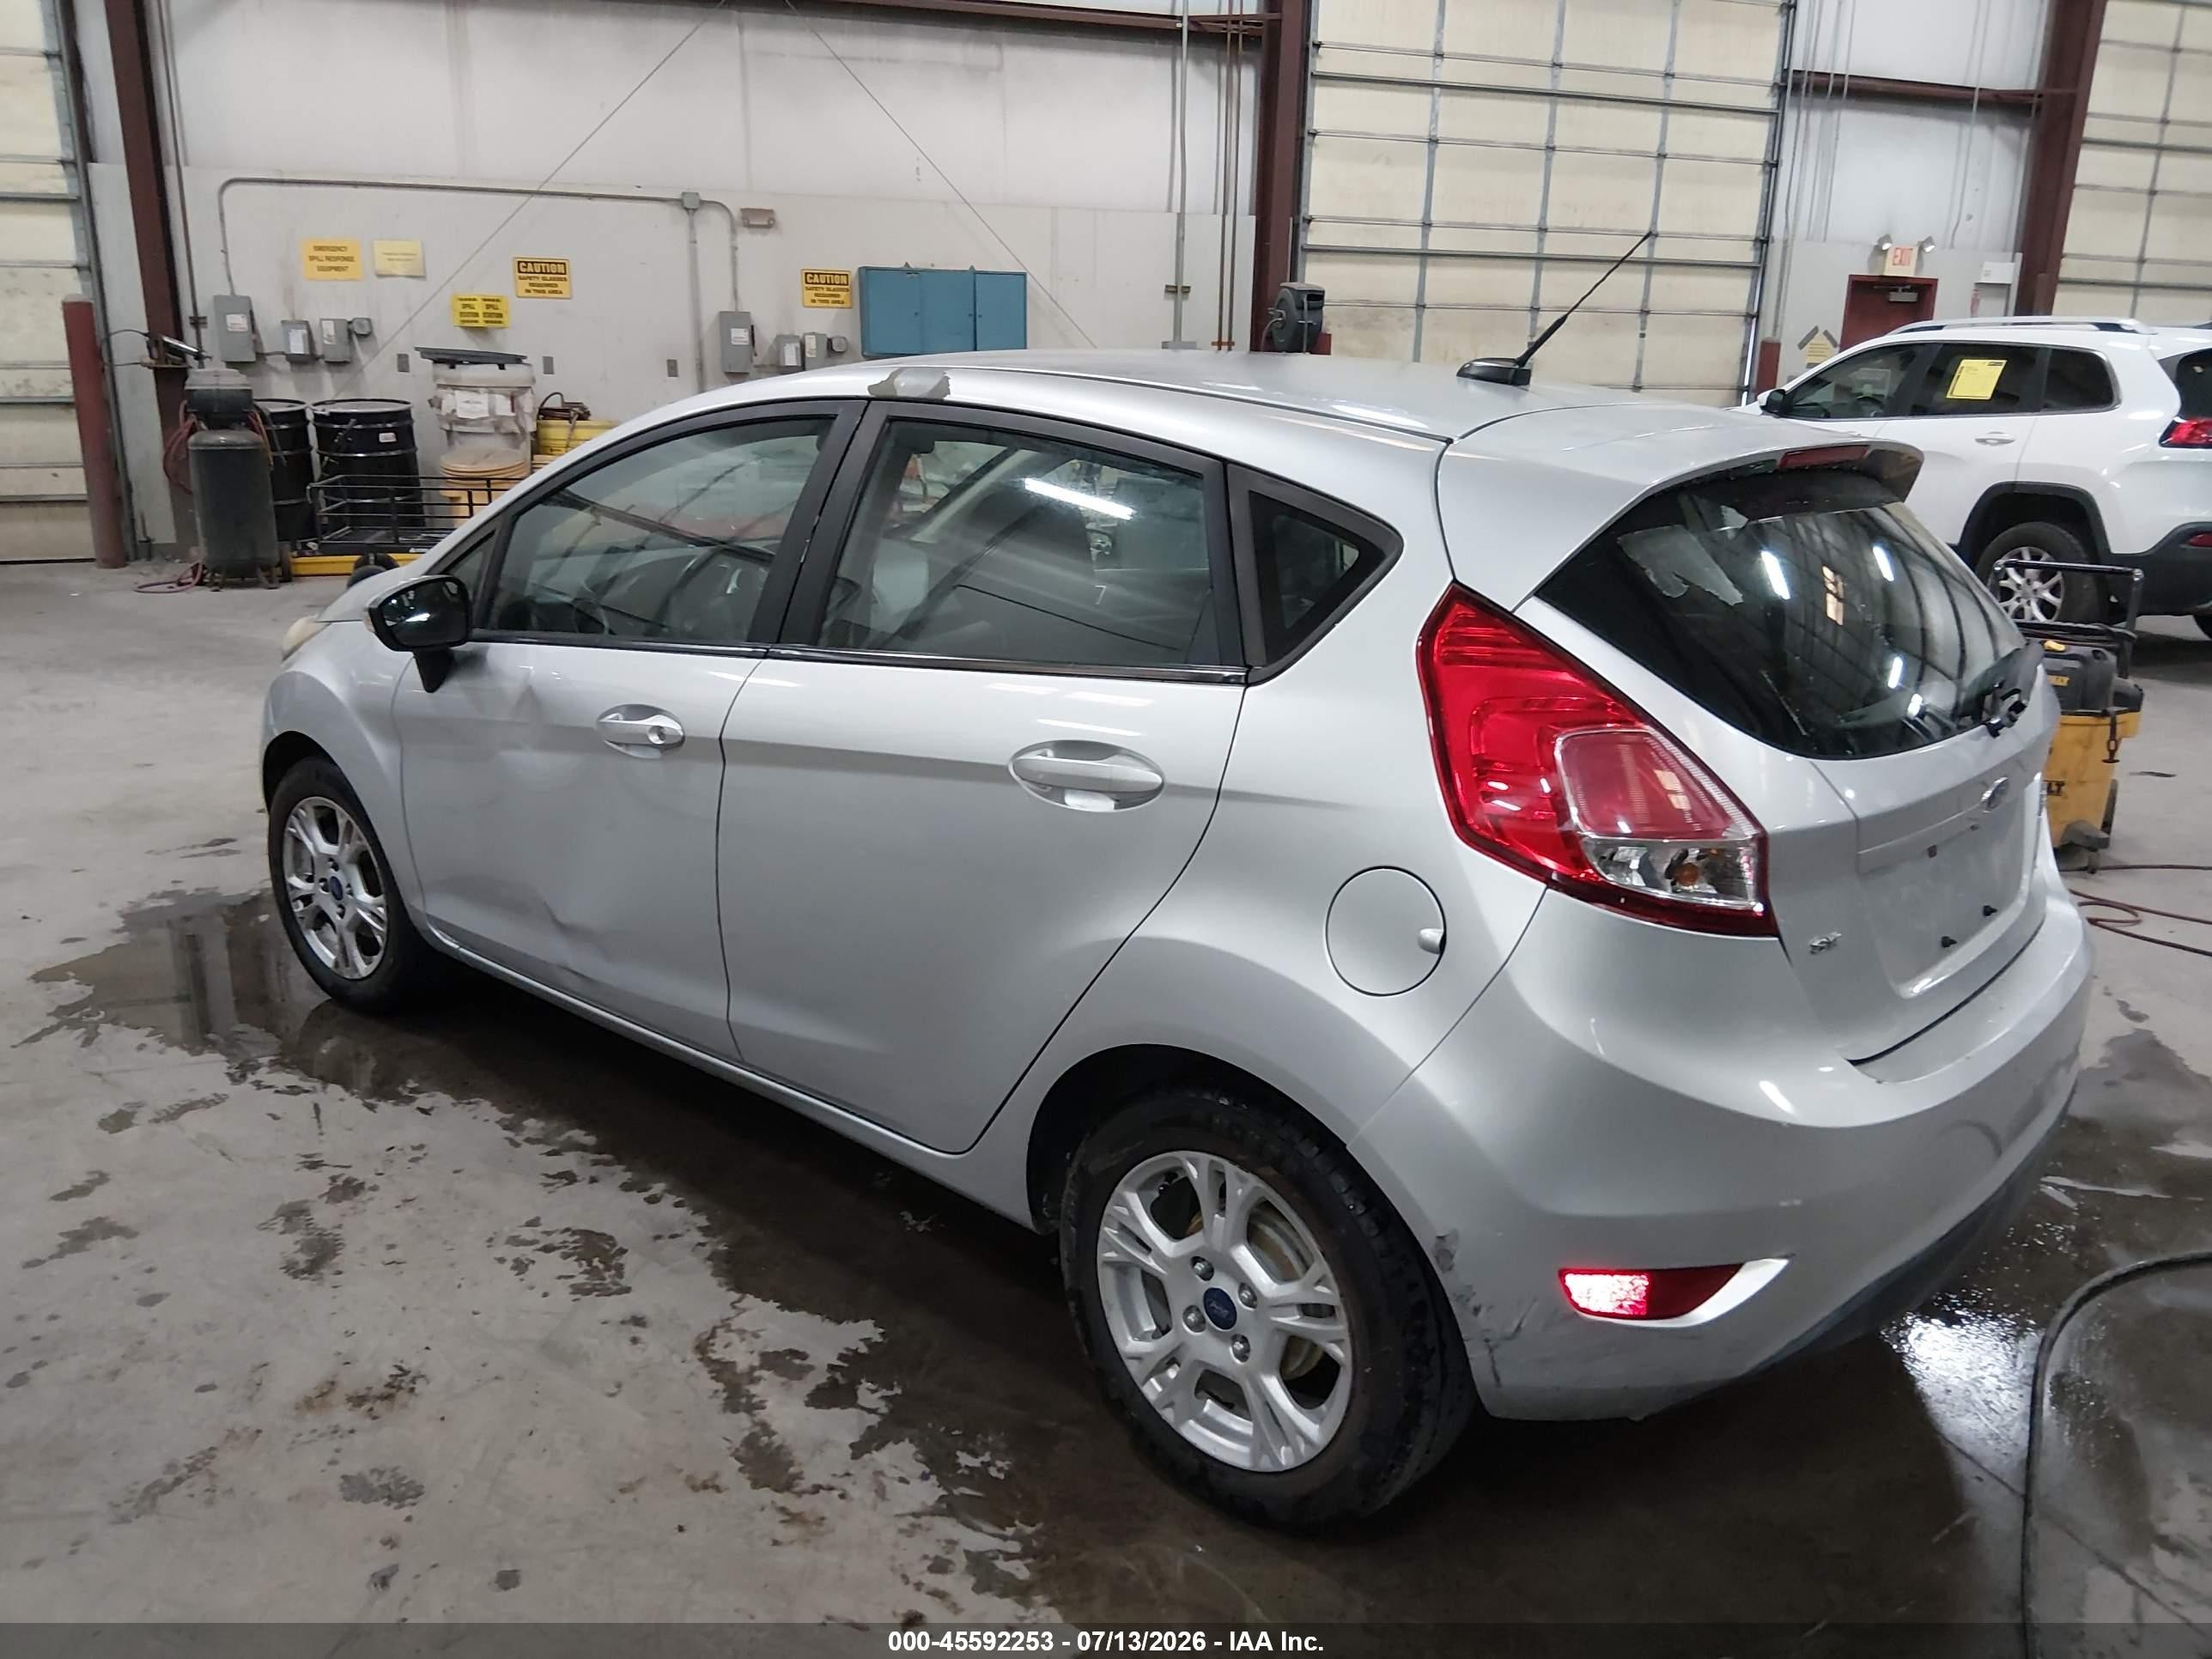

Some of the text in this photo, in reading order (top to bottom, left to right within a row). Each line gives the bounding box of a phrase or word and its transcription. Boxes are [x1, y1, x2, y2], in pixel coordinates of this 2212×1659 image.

[1892, 246, 1913, 266] EXIT
[519, 262, 566, 274] CAUTION
[806, 274, 848, 284] CAUTION
